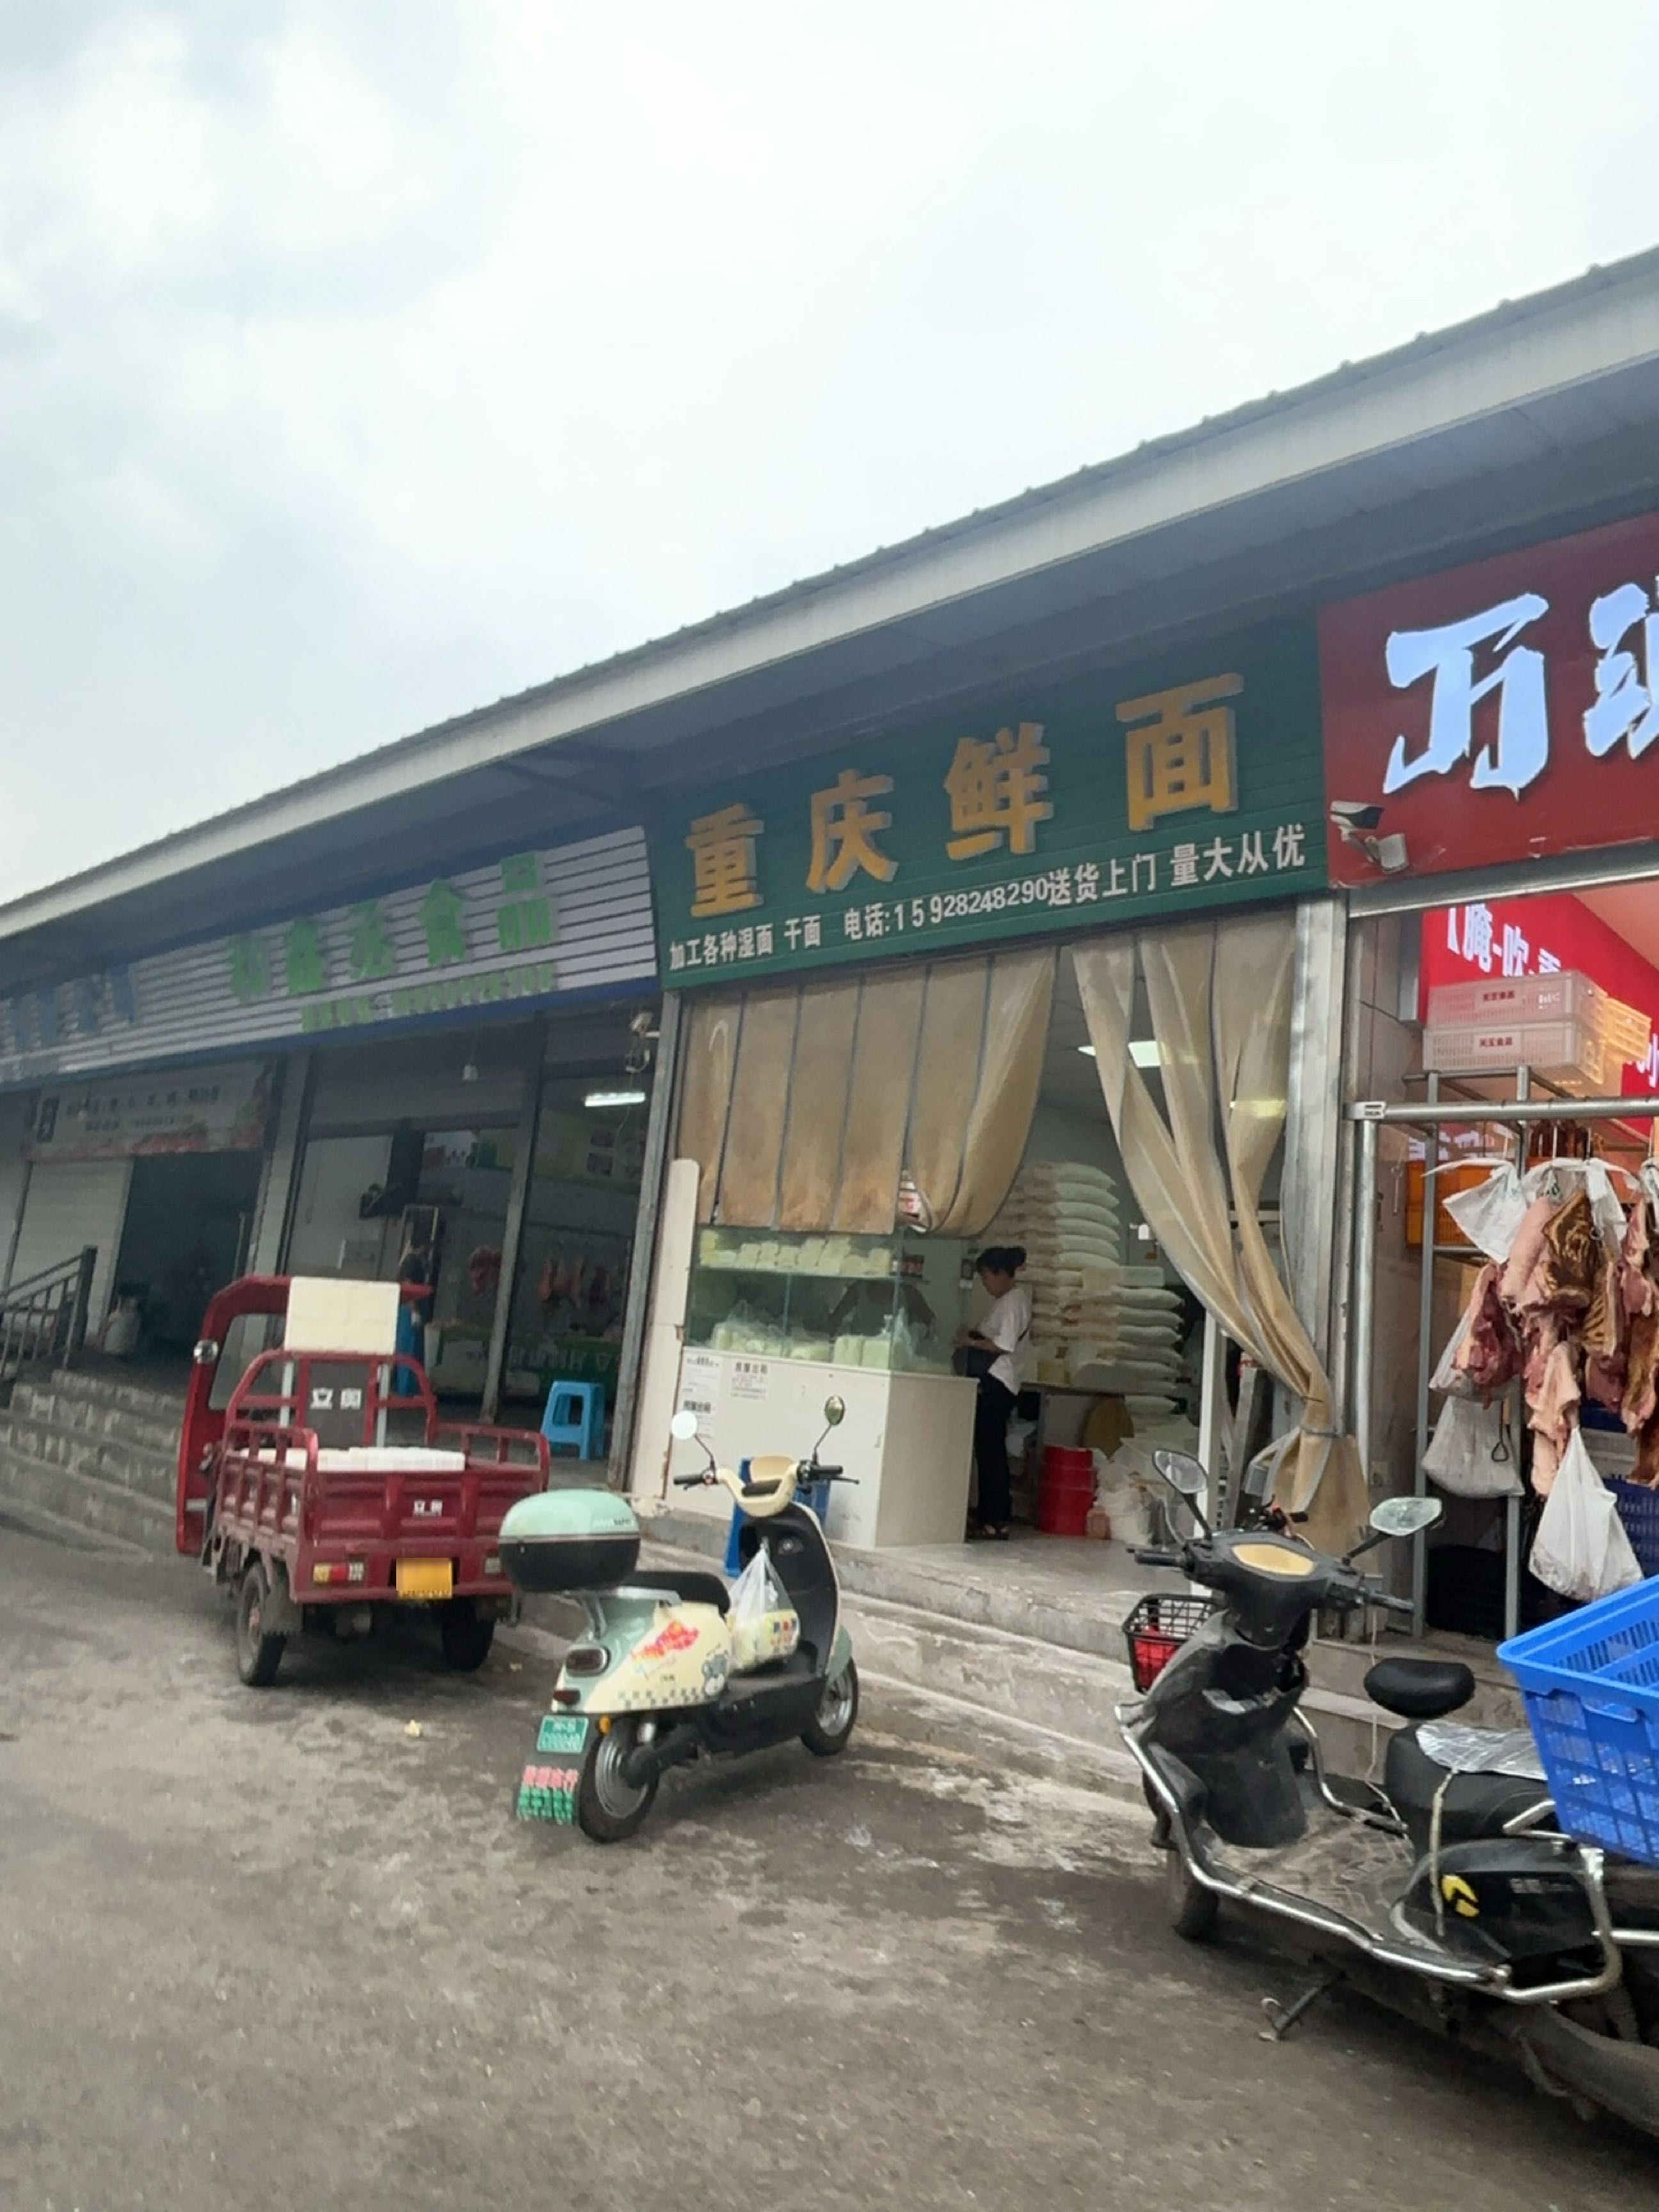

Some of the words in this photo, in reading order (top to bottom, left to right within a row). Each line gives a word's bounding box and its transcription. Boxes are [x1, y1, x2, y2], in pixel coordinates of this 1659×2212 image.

[685, 671, 1244, 918] 重庆鲜面
[669, 922, 773, 970] 加工各种湿面
[1170, 823, 1304, 886] 量大从优
